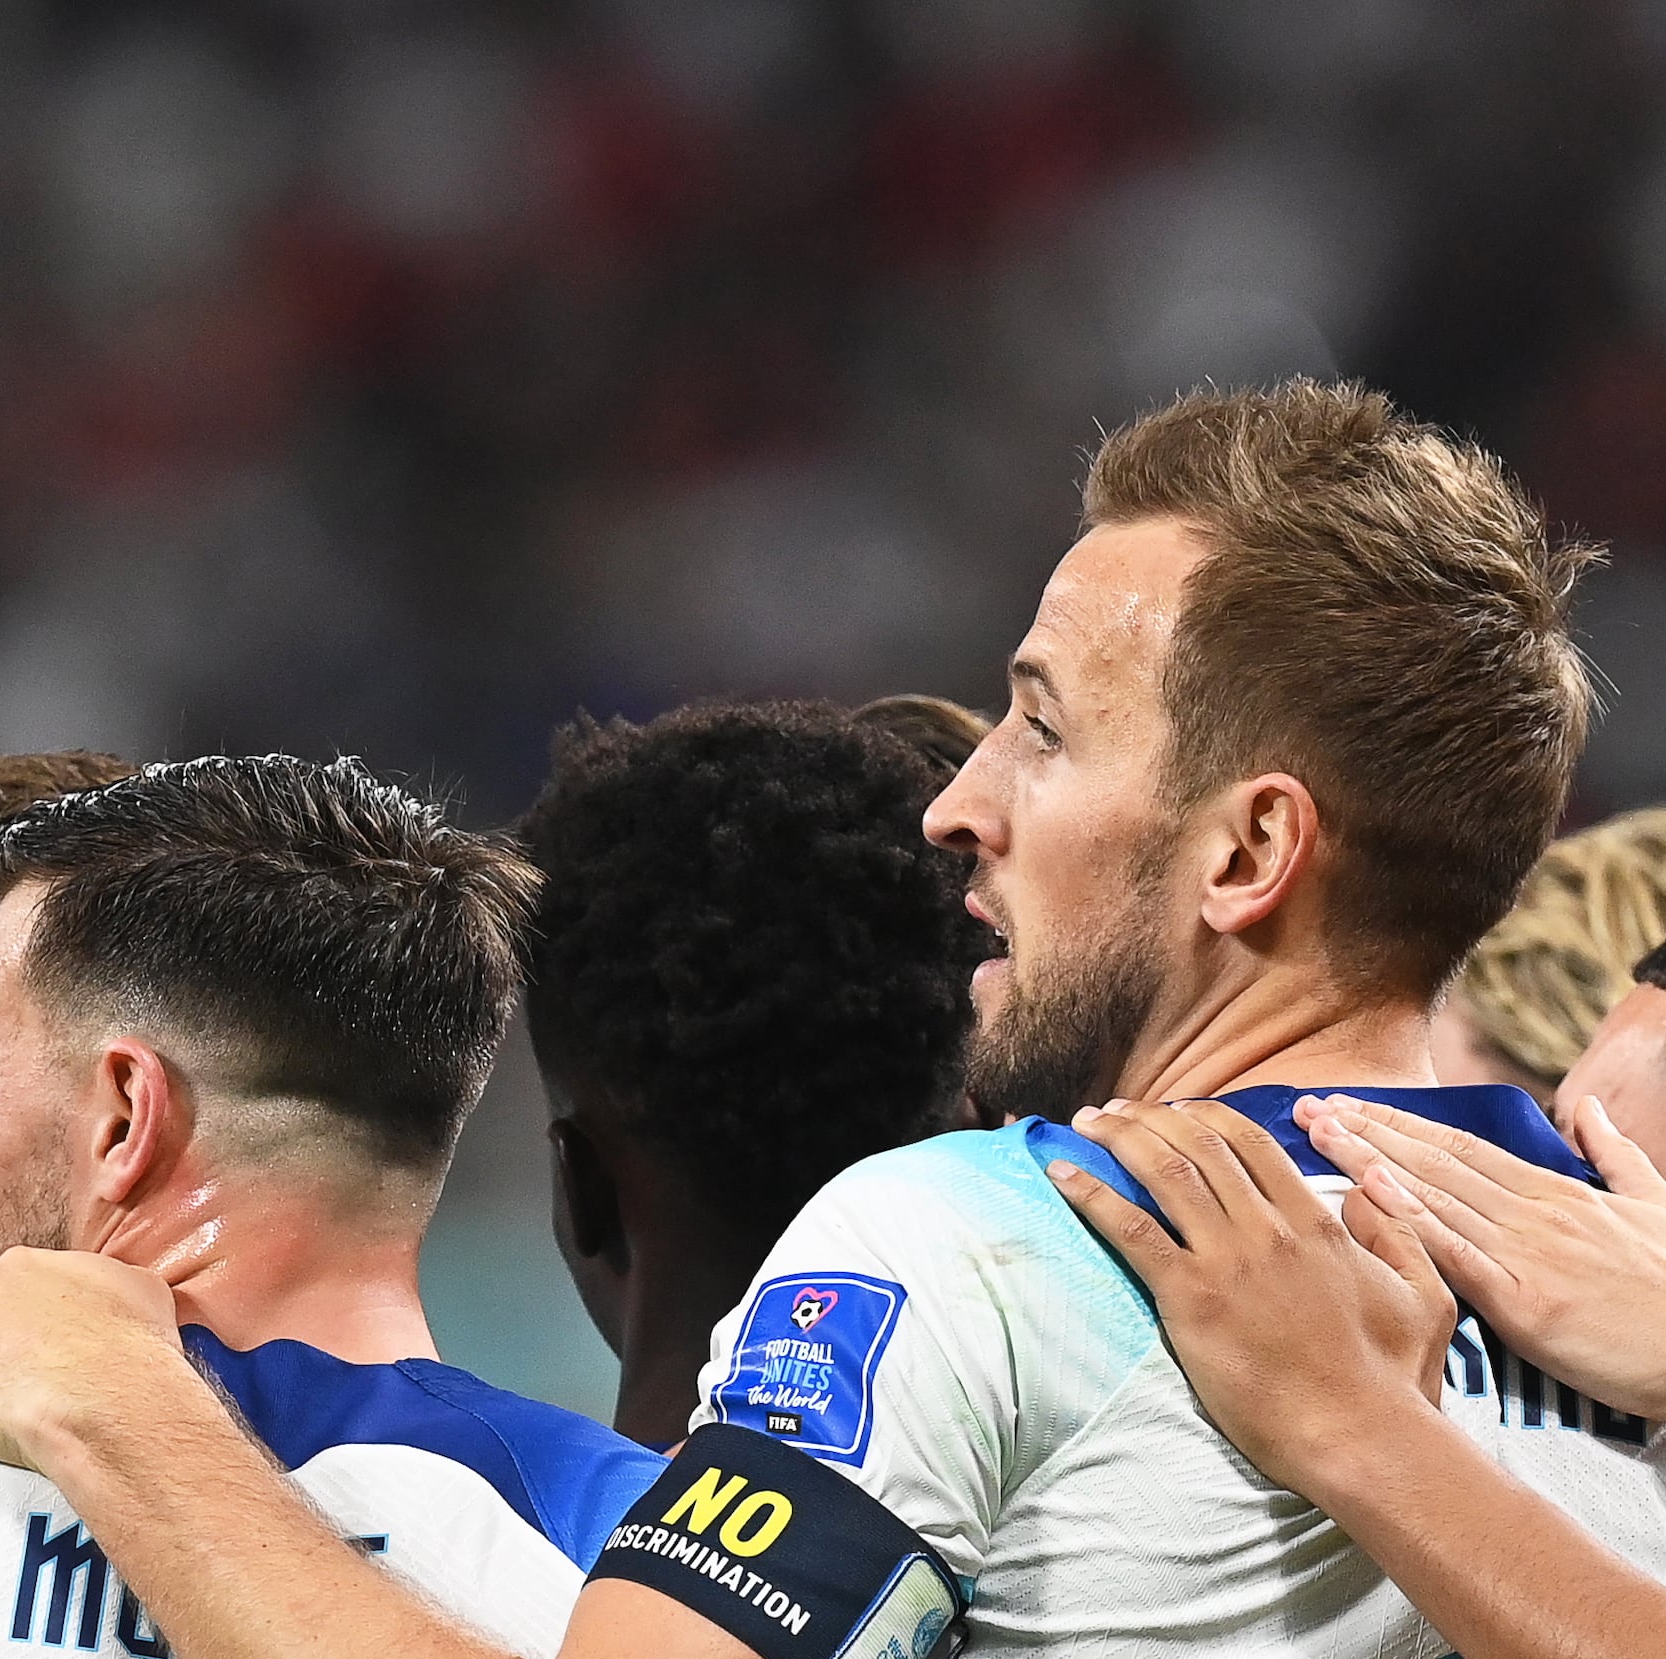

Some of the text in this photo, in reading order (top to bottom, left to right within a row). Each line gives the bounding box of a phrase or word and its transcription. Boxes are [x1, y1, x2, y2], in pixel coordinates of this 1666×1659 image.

[764, 1338, 835, 1365] FOOTBALL
[760, 1357, 833, 1391] UNITES
[747, 1383, 833, 1416] the World
[768, 1415, 798, 1432] FIFA
[660, 1466, 794, 1558] NO
[604, 1523, 812, 1636] DISCRIMINATION
